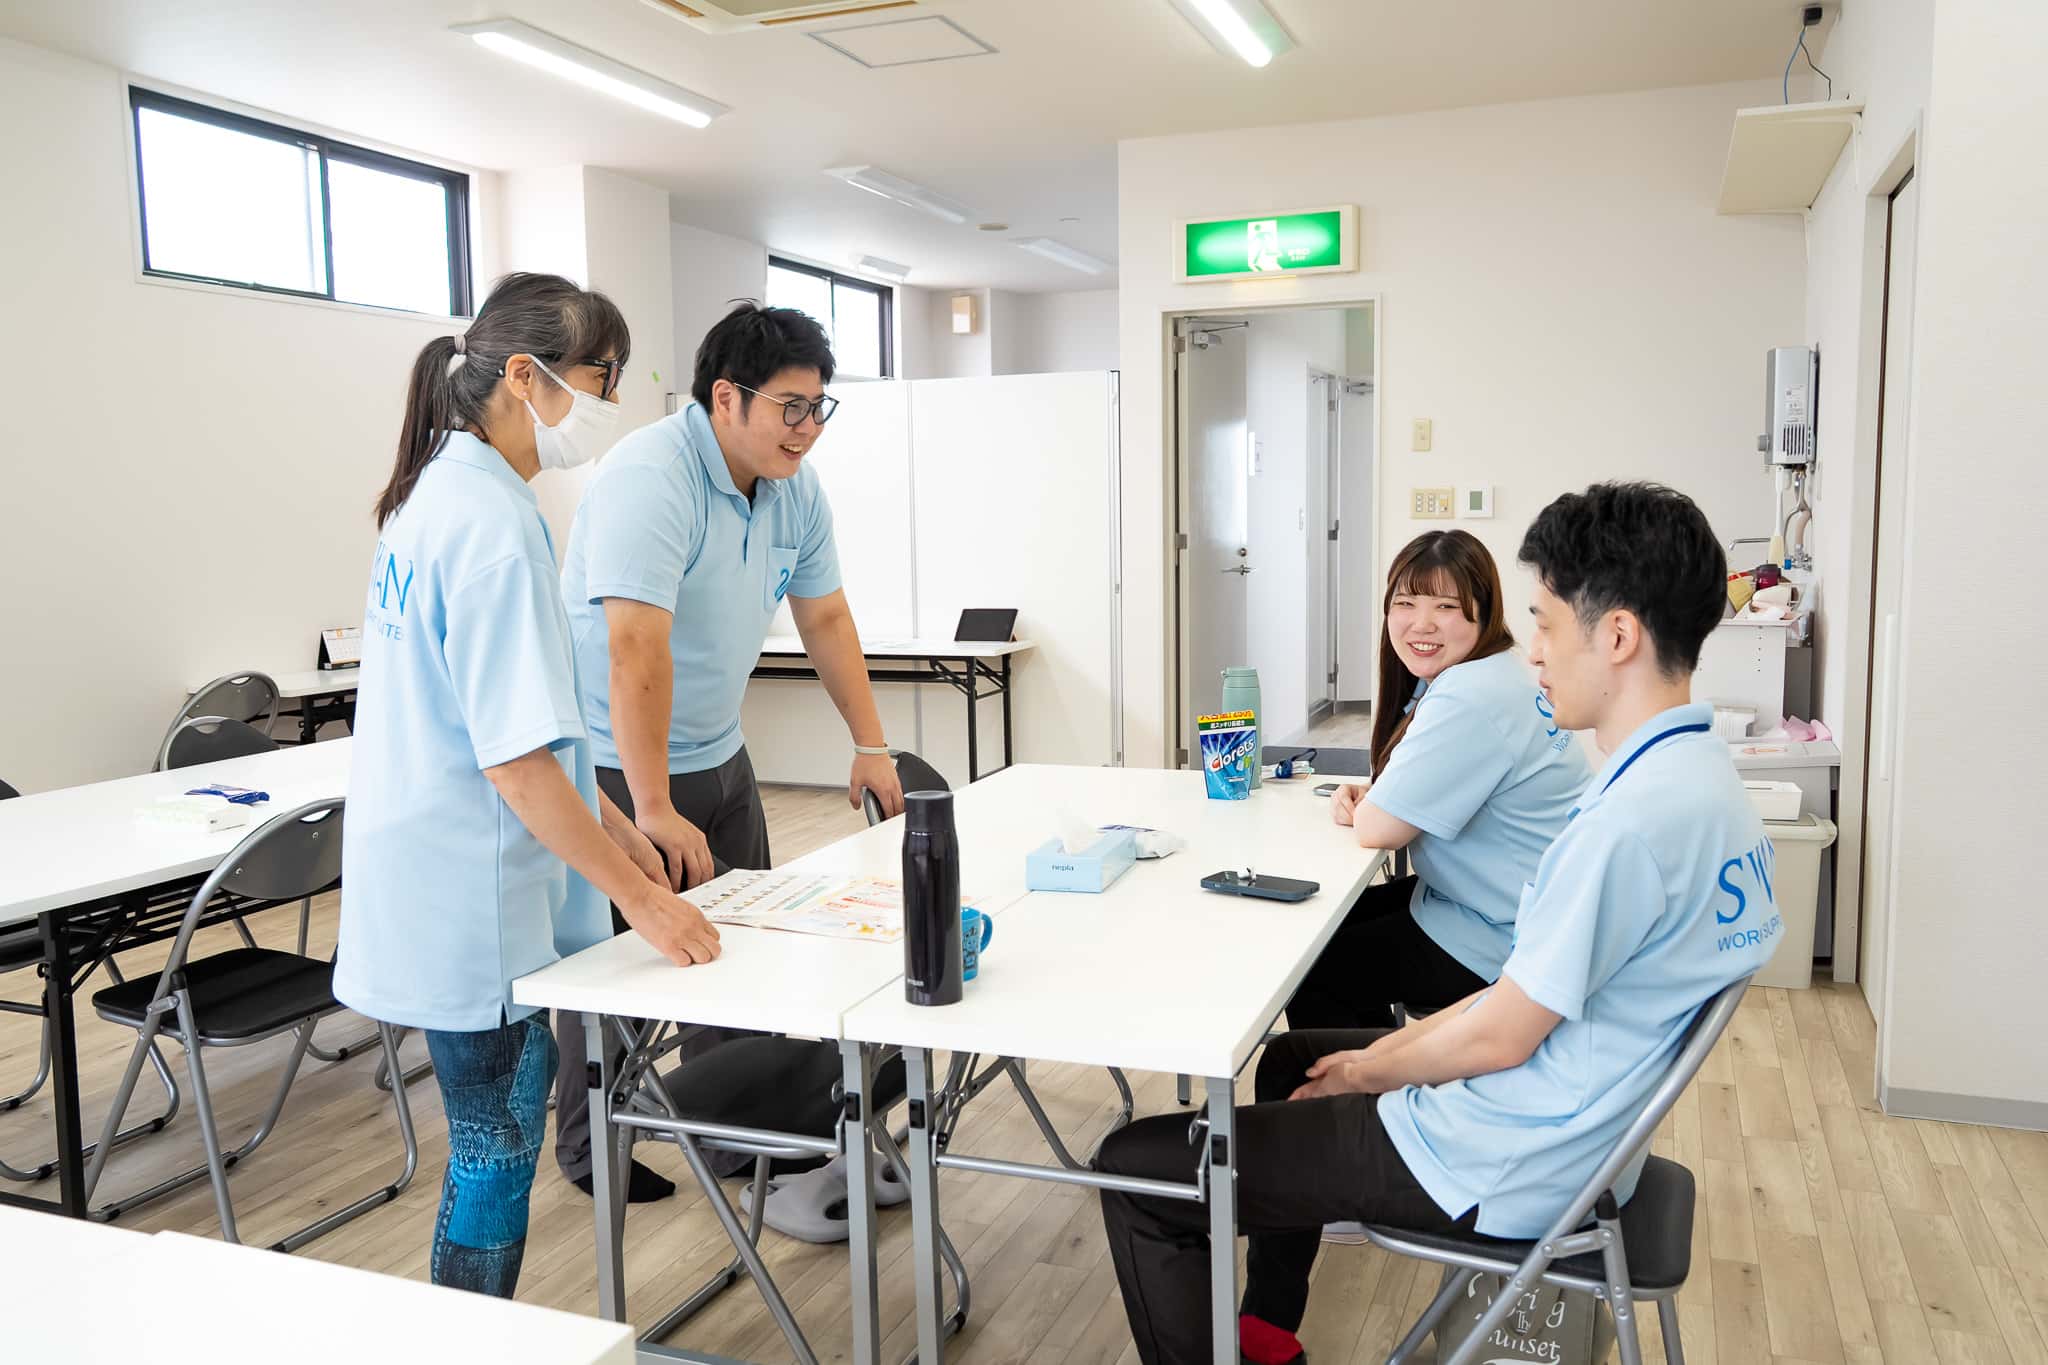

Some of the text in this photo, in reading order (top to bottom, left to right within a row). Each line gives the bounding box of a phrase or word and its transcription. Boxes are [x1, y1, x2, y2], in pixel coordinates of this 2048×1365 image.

[1210, 738, 1255, 772] Clorets
[1718, 929, 1763, 952] WOR
[1488, 1329, 1560, 1361] unset
